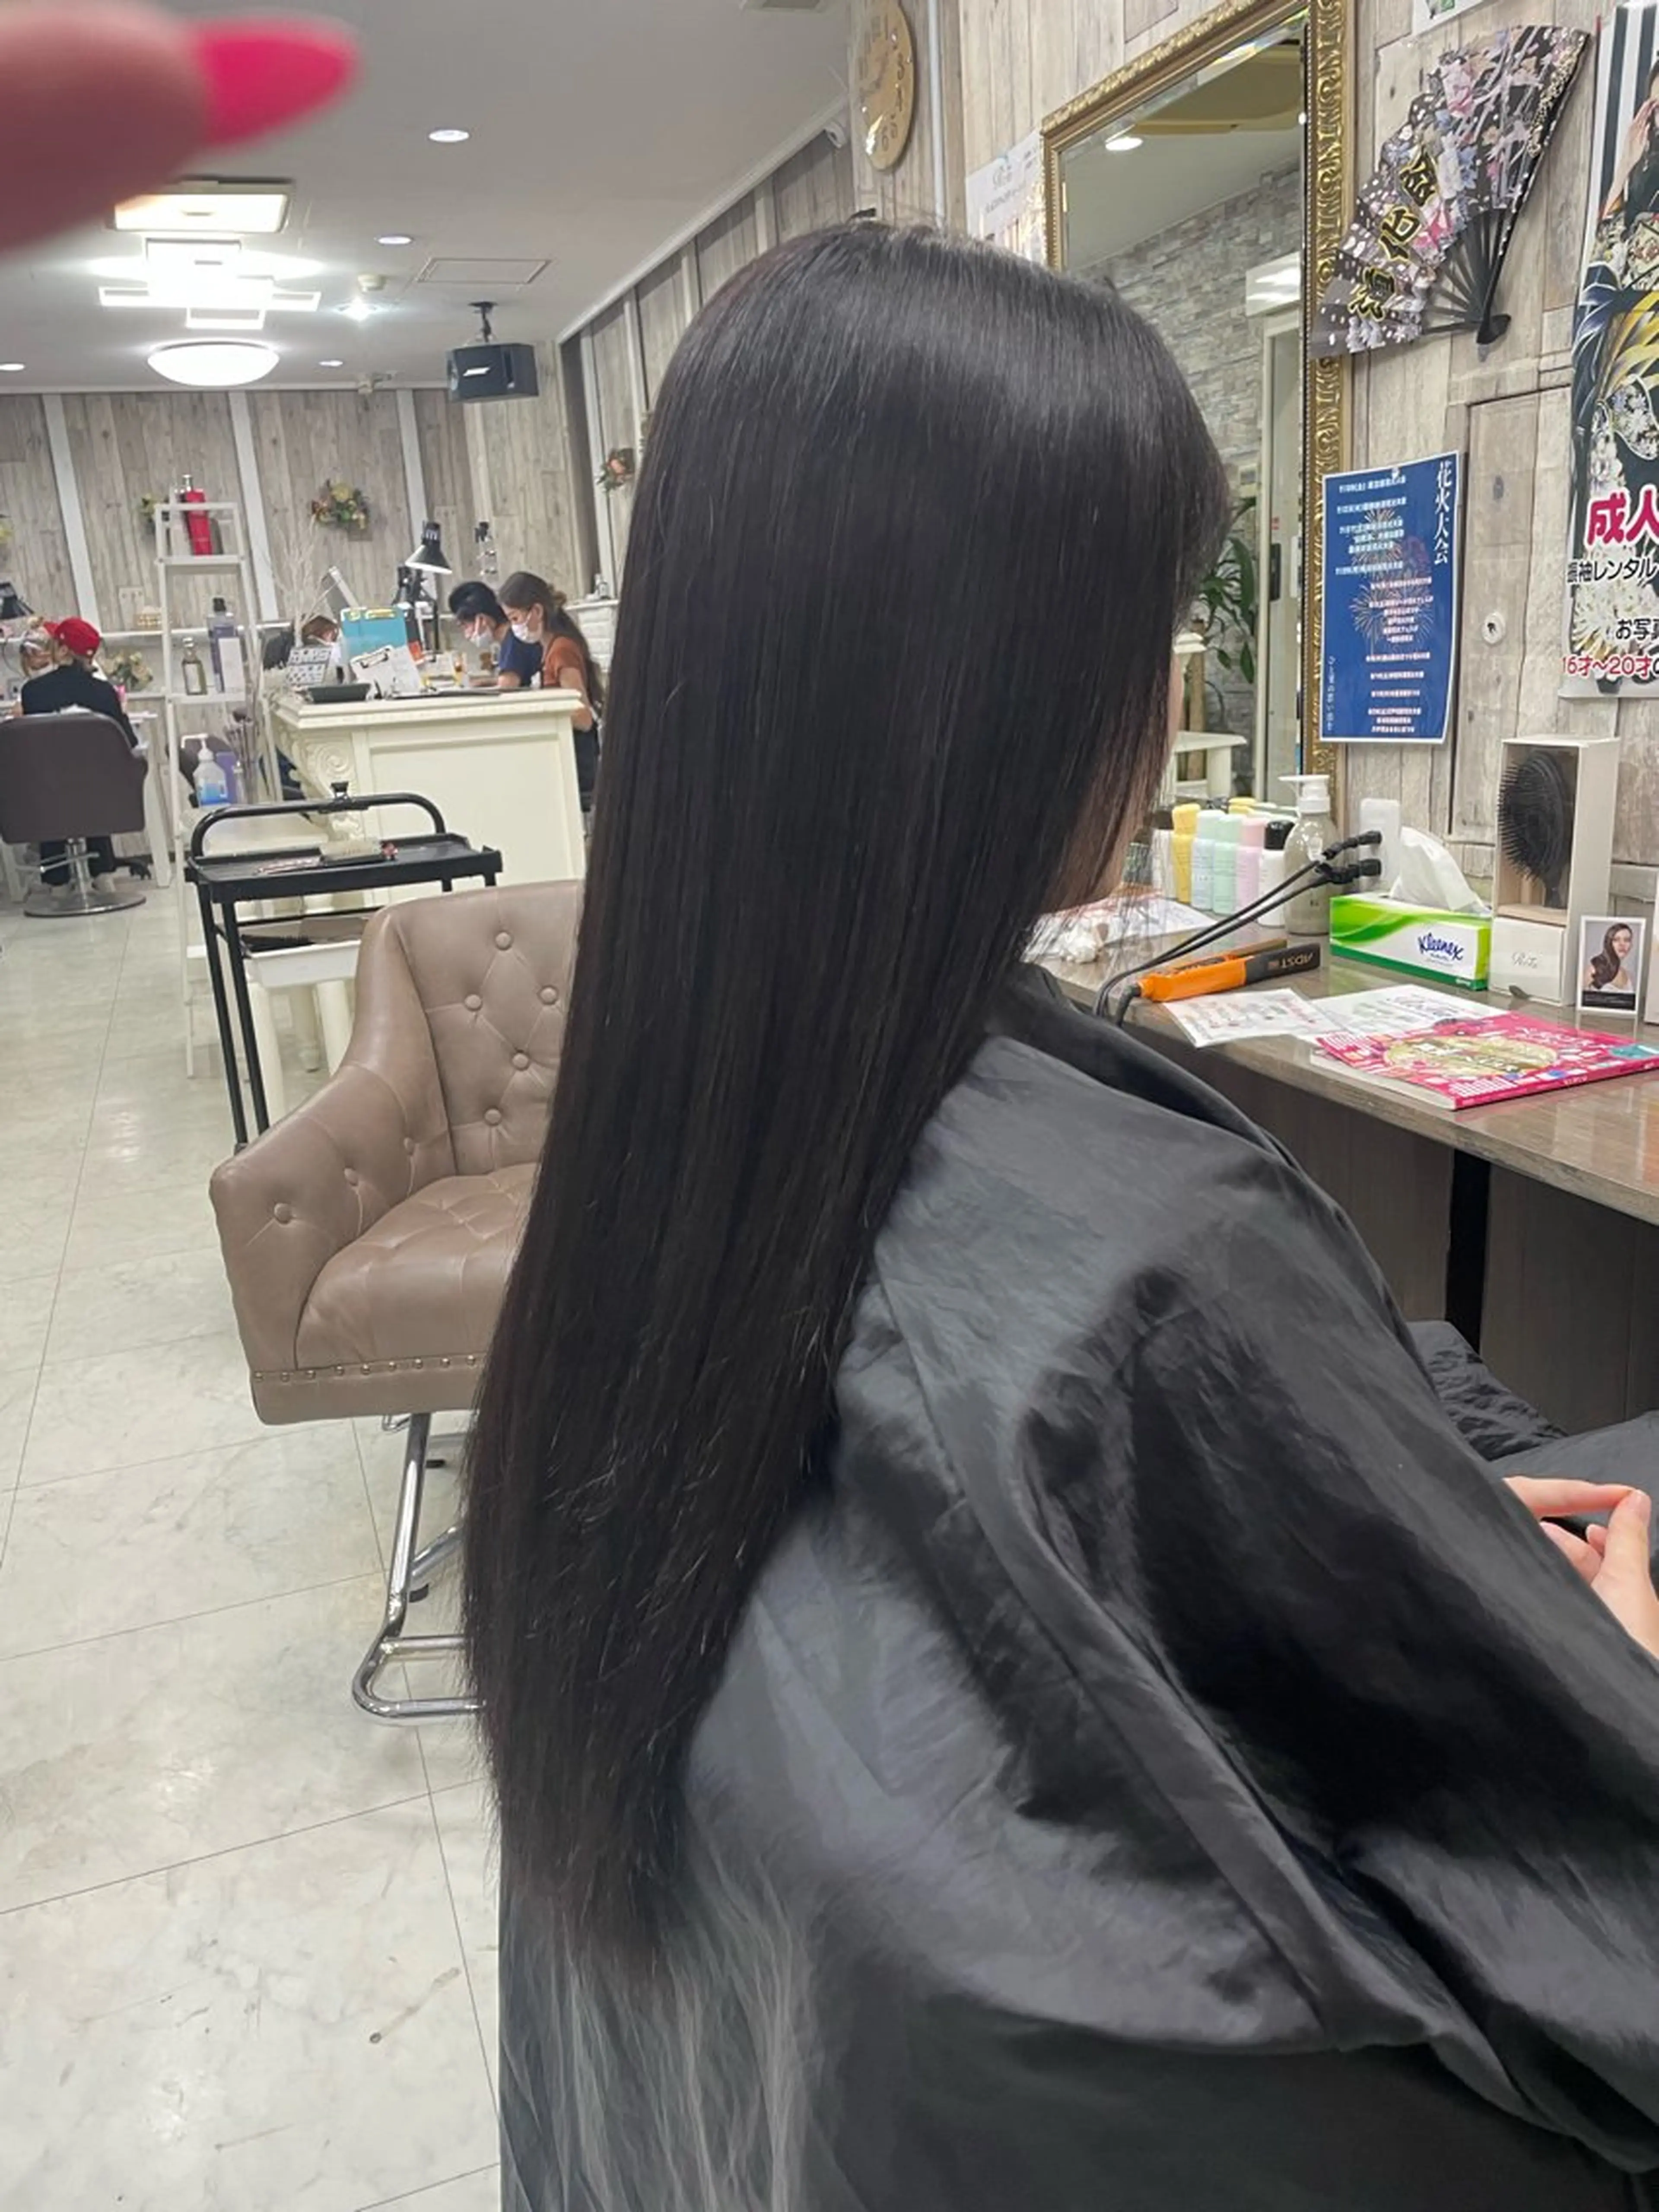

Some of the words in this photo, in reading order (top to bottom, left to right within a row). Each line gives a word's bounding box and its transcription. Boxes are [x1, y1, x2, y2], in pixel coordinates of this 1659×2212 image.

[1433, 460, 1452, 565] 花火大会
[1587, 489, 1659, 545] 成人
[1417, 932, 1464, 961] Kleenex
